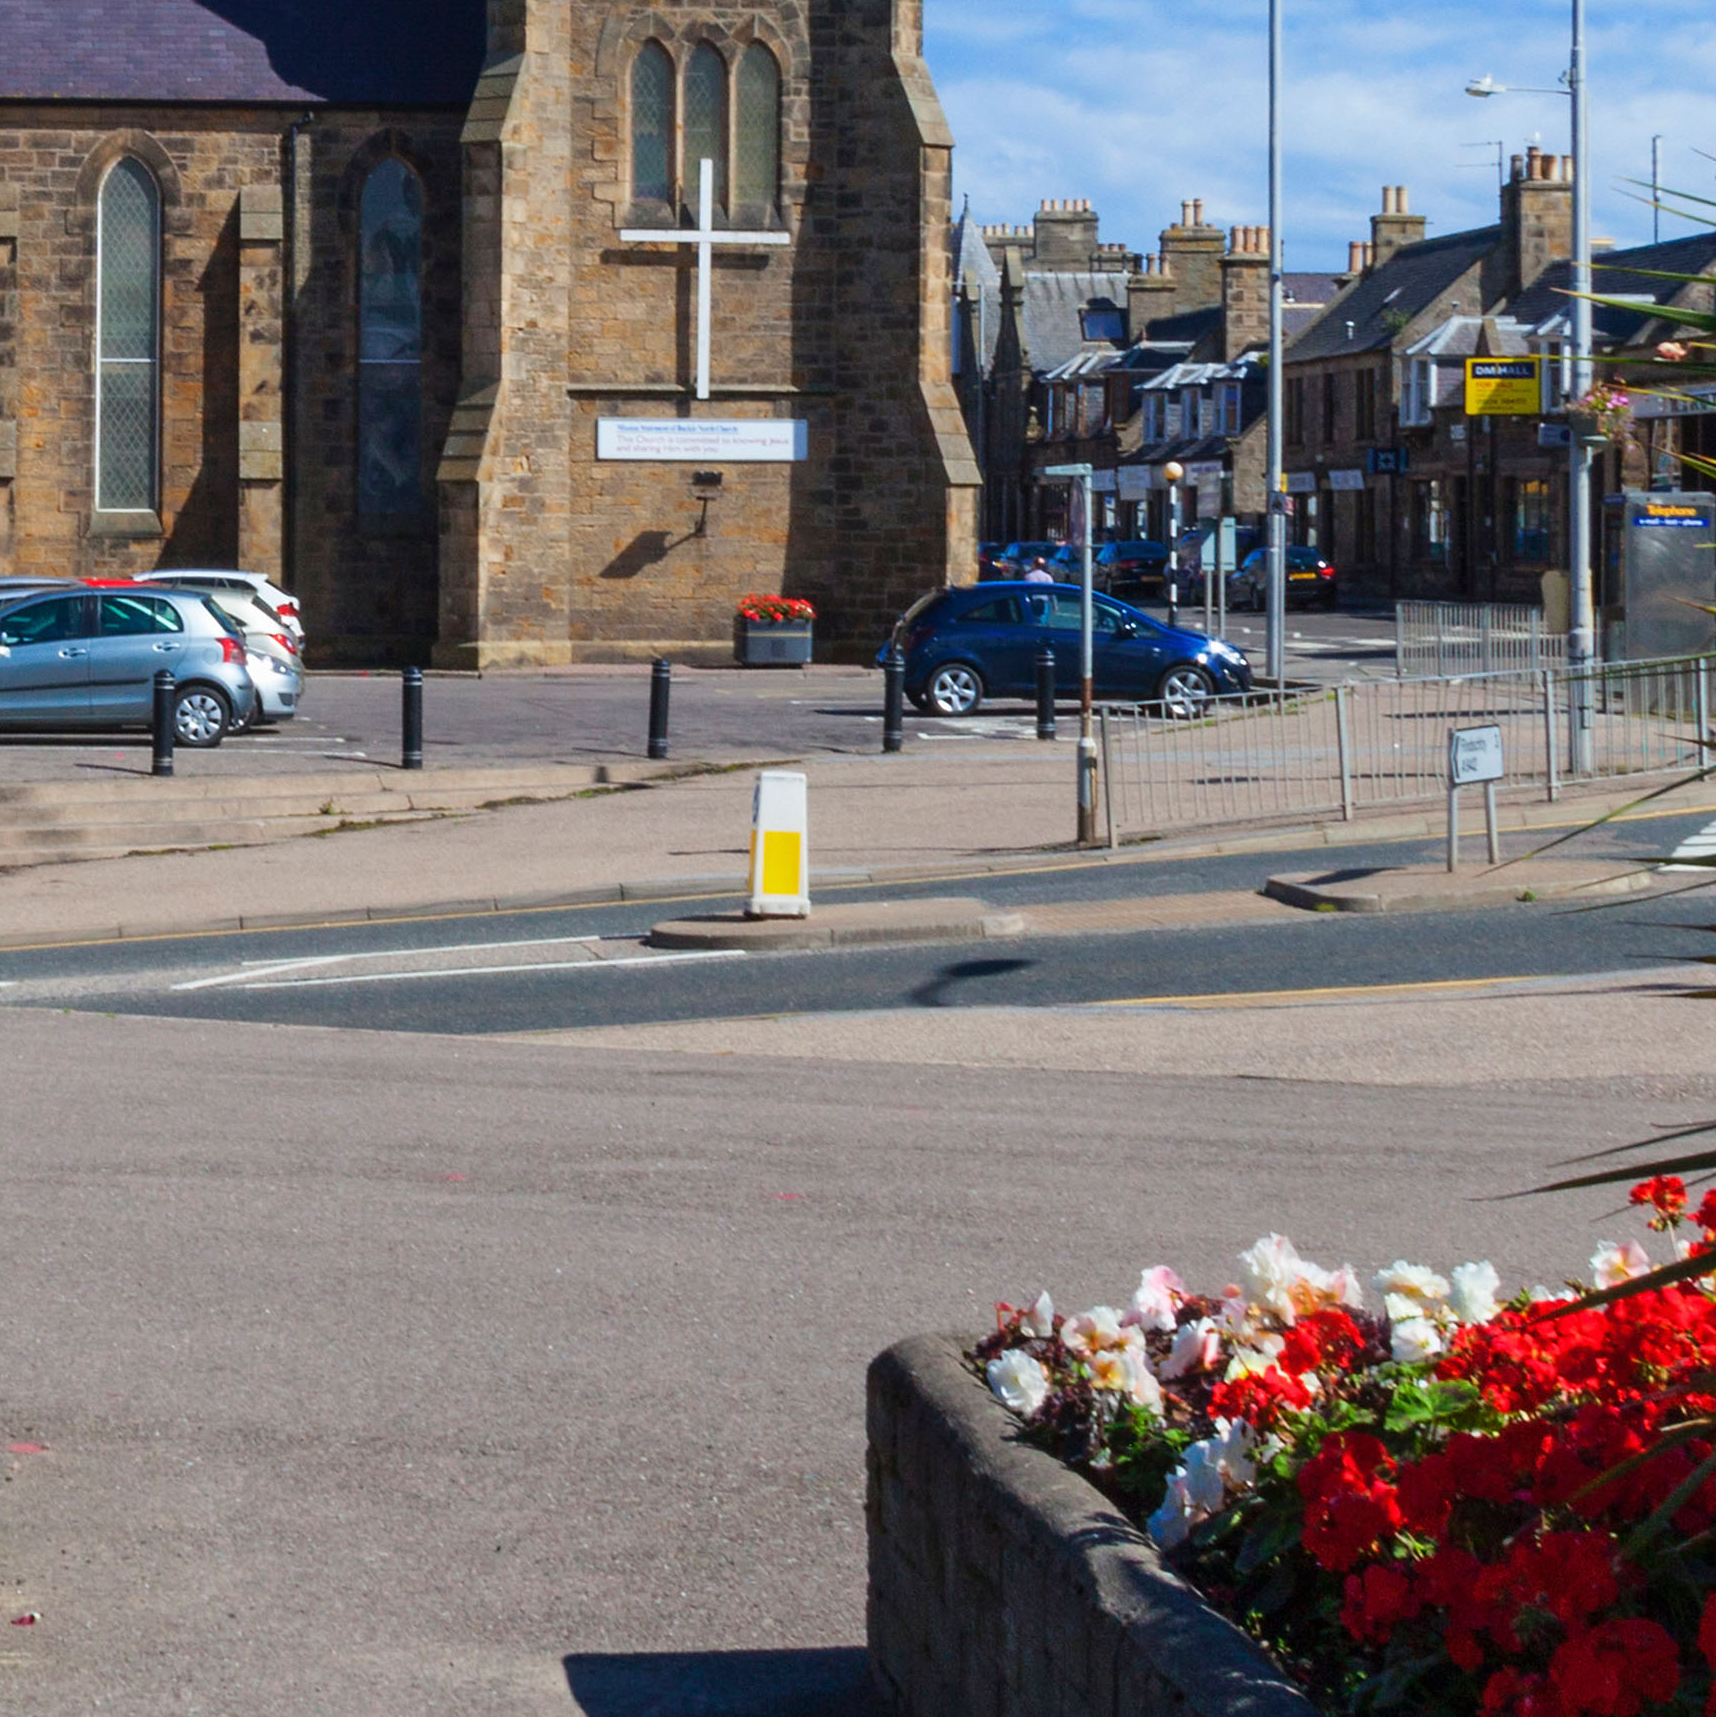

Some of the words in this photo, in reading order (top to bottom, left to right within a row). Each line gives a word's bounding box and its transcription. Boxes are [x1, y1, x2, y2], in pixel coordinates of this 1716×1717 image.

[1498, 366, 1530, 376] HALL
[617, 434, 634, 443] This
[635, 434, 666, 443] Church
[676, 435, 720, 444] committed
[732, 436, 767, 447] knowing
[768, 436, 790, 447] Jesus
[633, 444, 661, 454] sharing
[1646, 504, 1697, 517] Telephone
